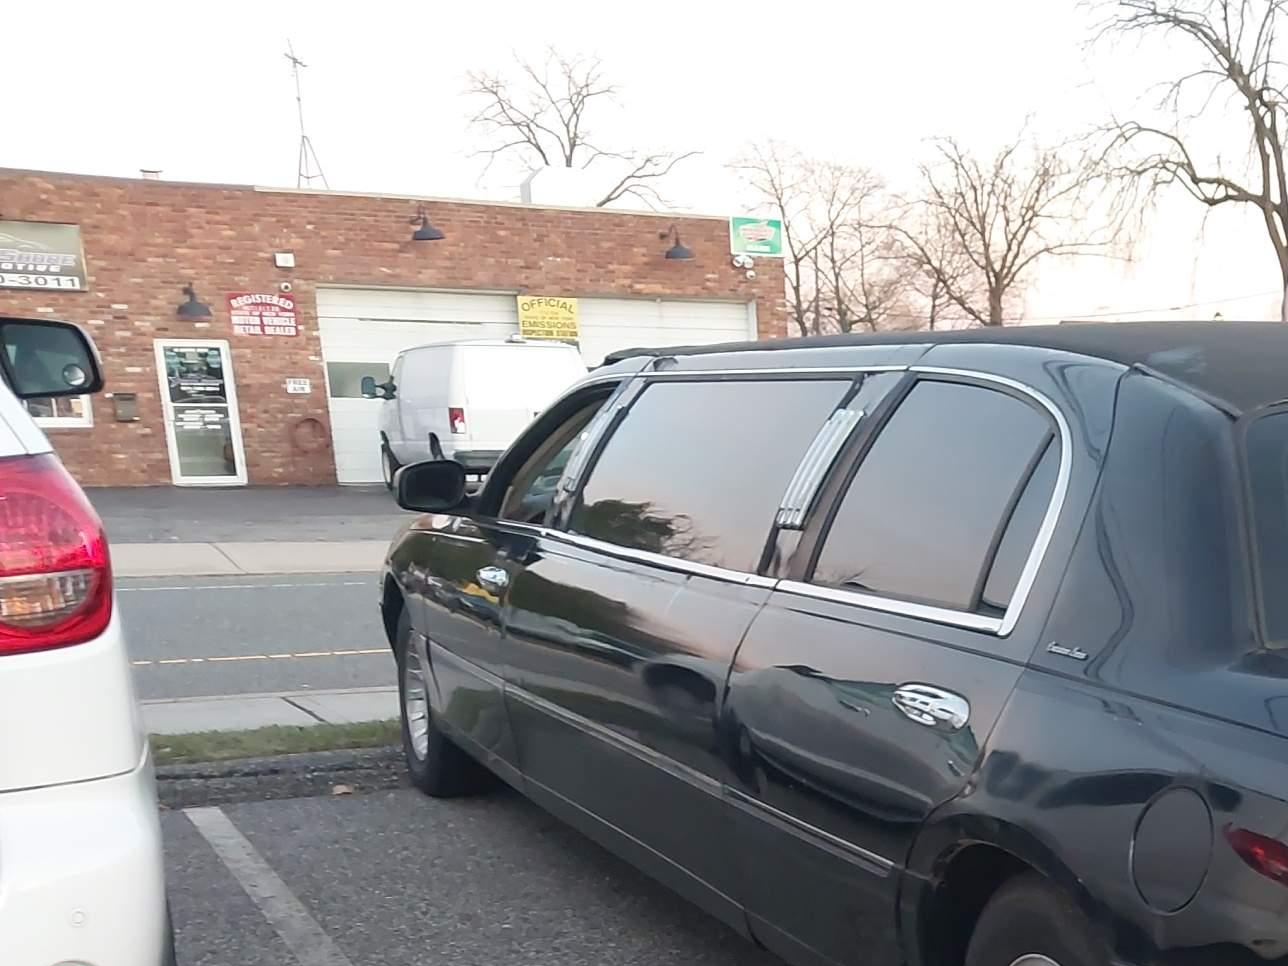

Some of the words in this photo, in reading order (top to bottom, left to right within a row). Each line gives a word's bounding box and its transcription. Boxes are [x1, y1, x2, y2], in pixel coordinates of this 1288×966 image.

[230, 294, 294, 309] REGISTERED
[521, 298, 575, 314] OFFICIAL
[264, 326, 297, 336] DEALER
[522, 320, 577, 330] EMISSIONS
